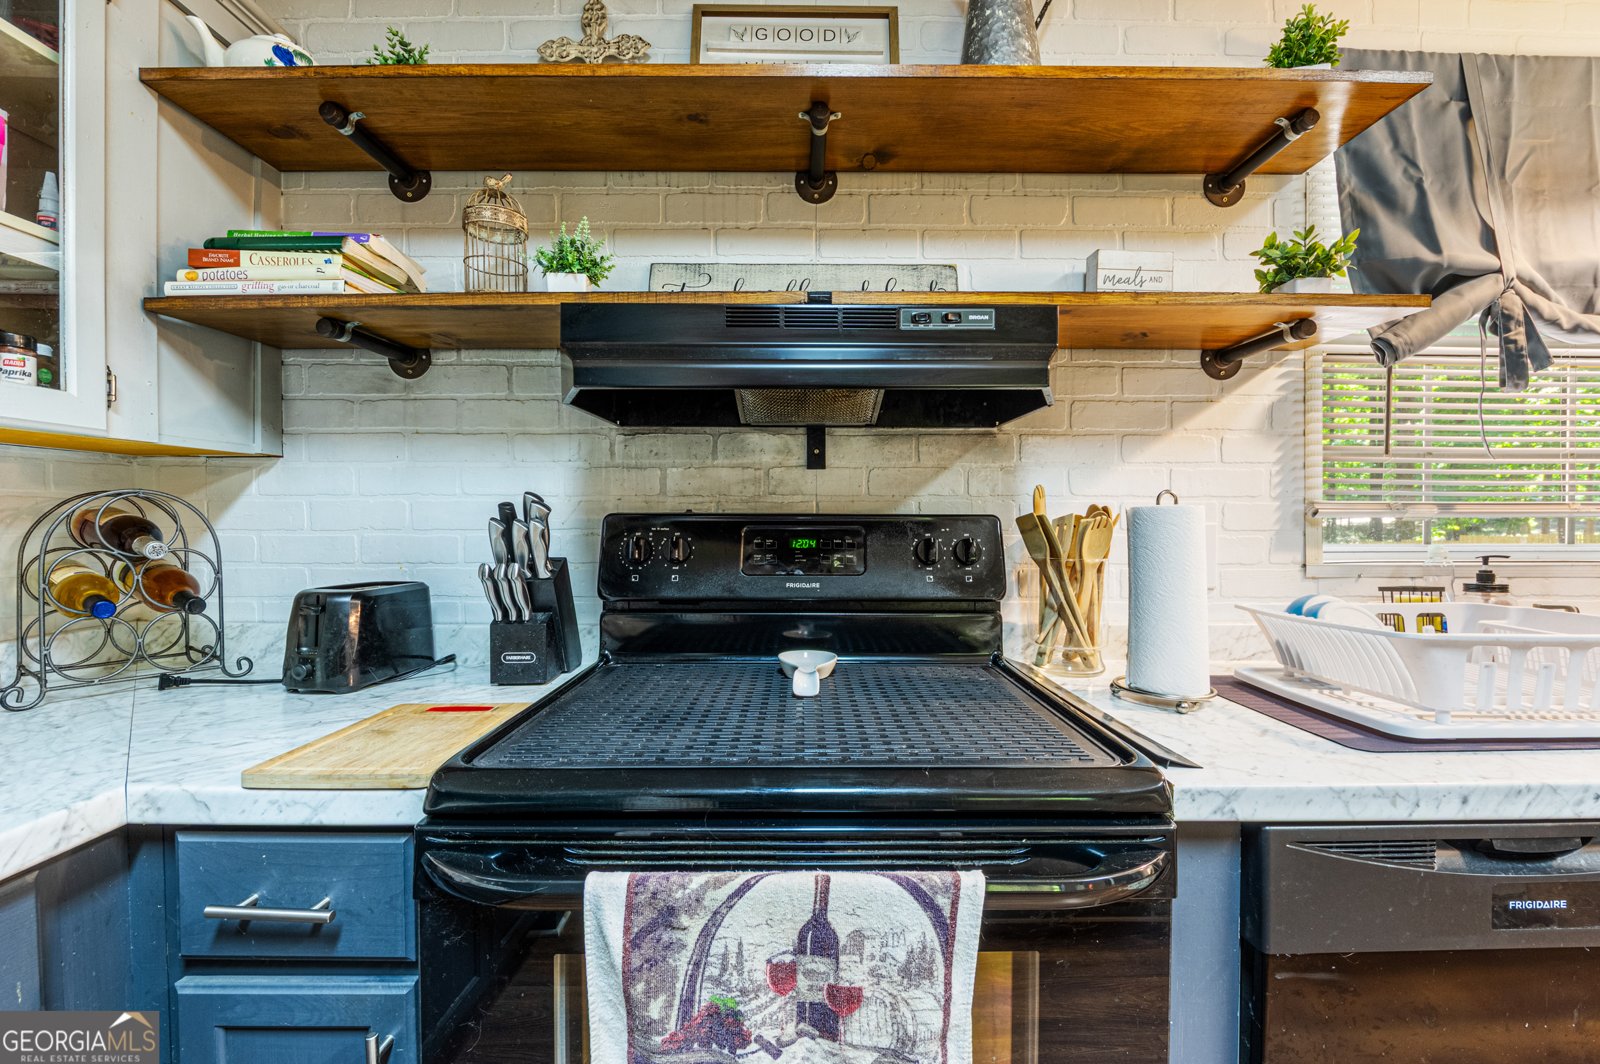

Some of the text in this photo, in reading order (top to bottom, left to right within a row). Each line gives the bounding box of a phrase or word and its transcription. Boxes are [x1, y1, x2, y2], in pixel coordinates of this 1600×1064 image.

[754, 27, 836, 42] GOOD
[202, 268, 248, 281] potatoes
[1149, 276, 1163, 284] AND
[241, 281, 275, 293] grilling
[1509, 900, 1567, 909] FRIGIDAIRE
